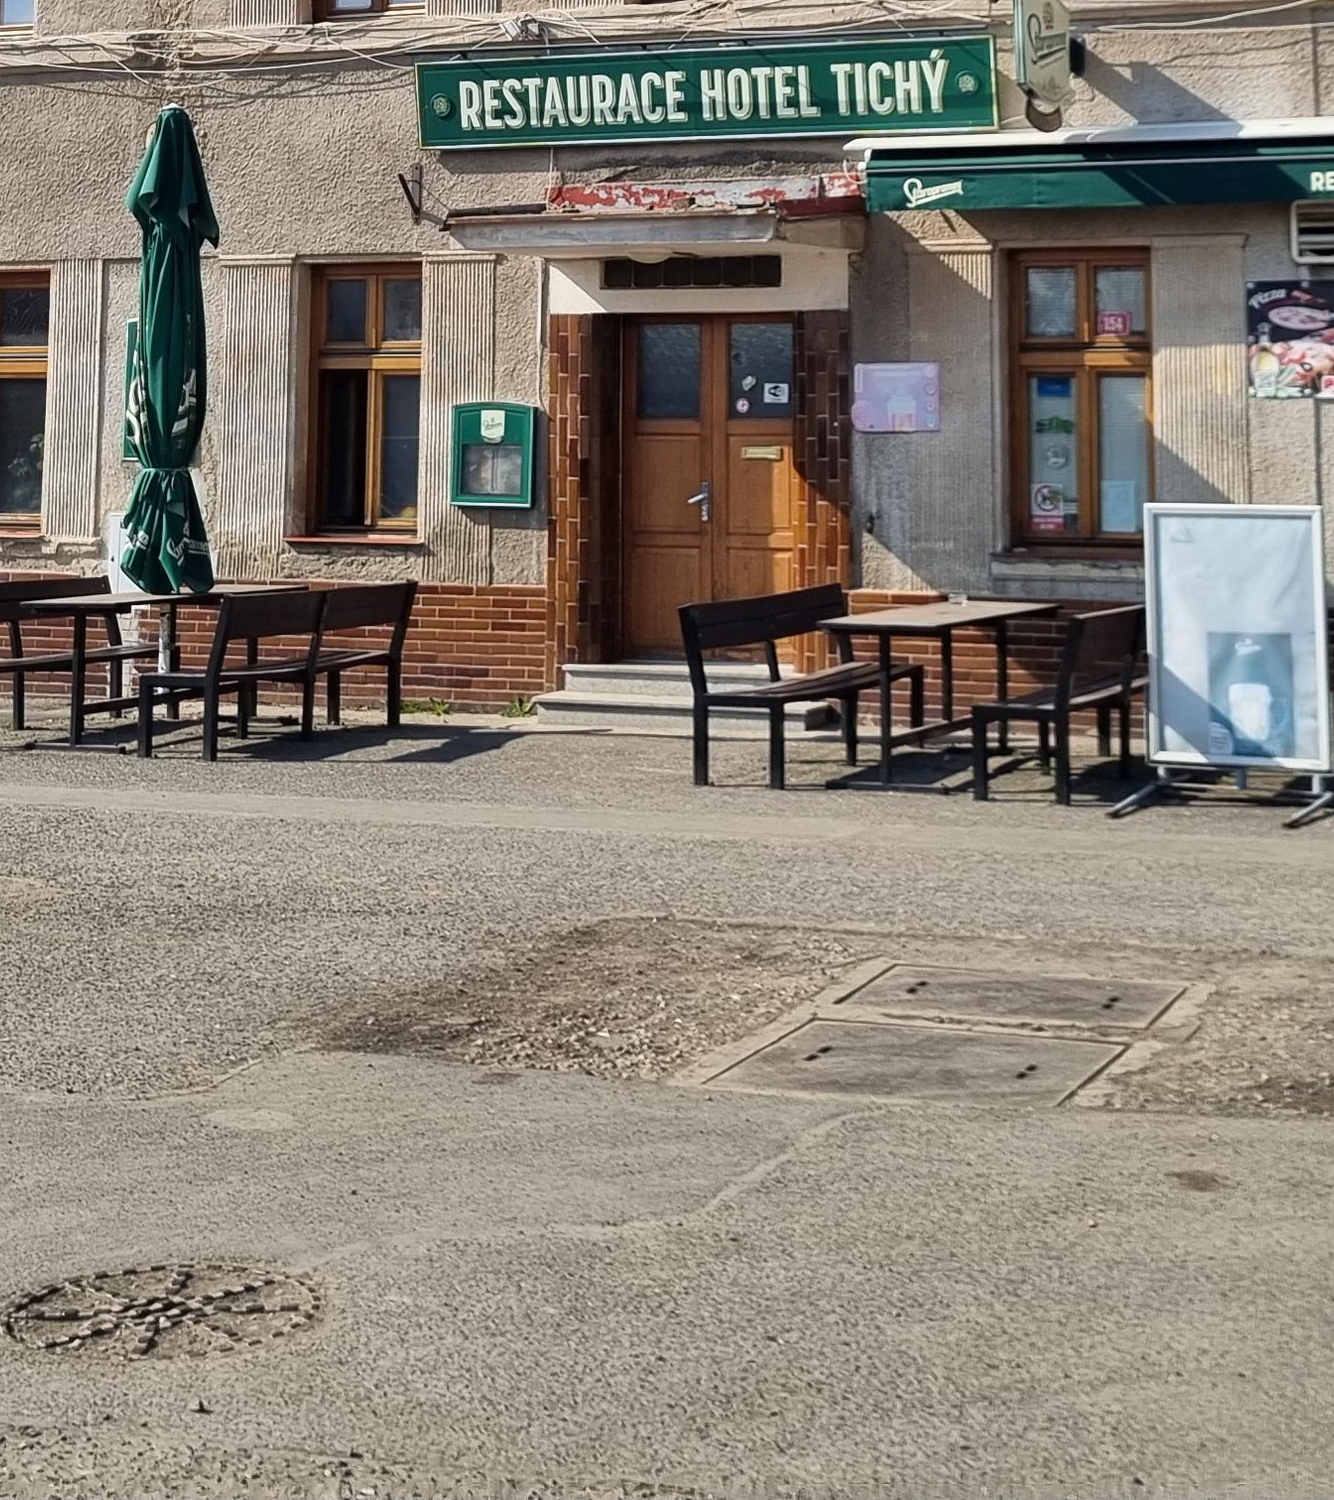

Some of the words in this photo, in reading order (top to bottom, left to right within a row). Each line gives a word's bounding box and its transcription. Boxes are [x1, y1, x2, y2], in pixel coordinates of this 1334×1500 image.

[458, 69, 689, 131] RESTAURACE
[701, 63, 821, 122] HOTEL
[830, 48, 950, 118] TICHÝ
